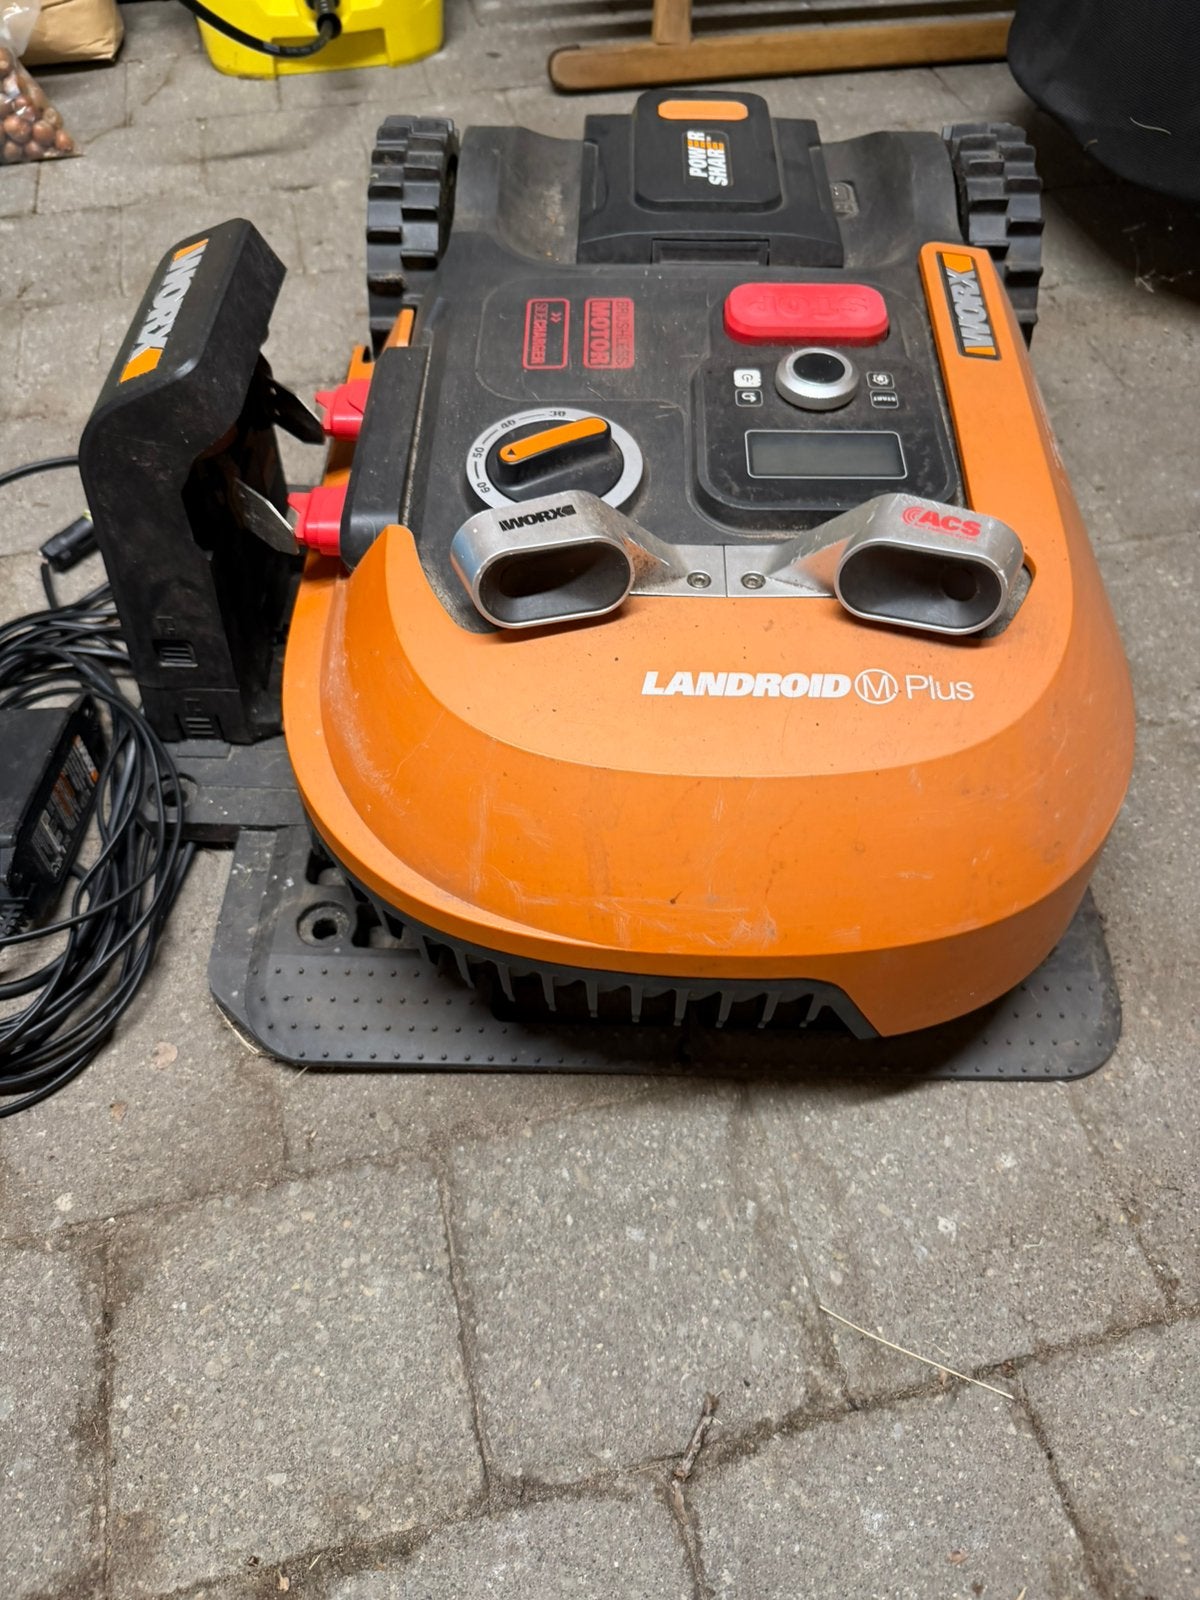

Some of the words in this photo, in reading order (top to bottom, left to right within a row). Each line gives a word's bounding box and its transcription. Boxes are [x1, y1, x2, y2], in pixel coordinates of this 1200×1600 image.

[687, 130, 708, 178] POWER
[707, 137, 728, 186] SHARE
[129, 245, 207, 362] WORX
[749, 294, 868, 321] STOP
[945, 268, 994, 347] WORX
[590, 301, 611, 364] MOTOR
[472, 446, 485, 458] 50
[476, 481, 490, 494] 60
[499, 508, 567, 532] WORX
[917, 510, 981, 537] ACS
[642, 671, 850, 698] LANDROID
[906, 674, 974, 701] Plus
